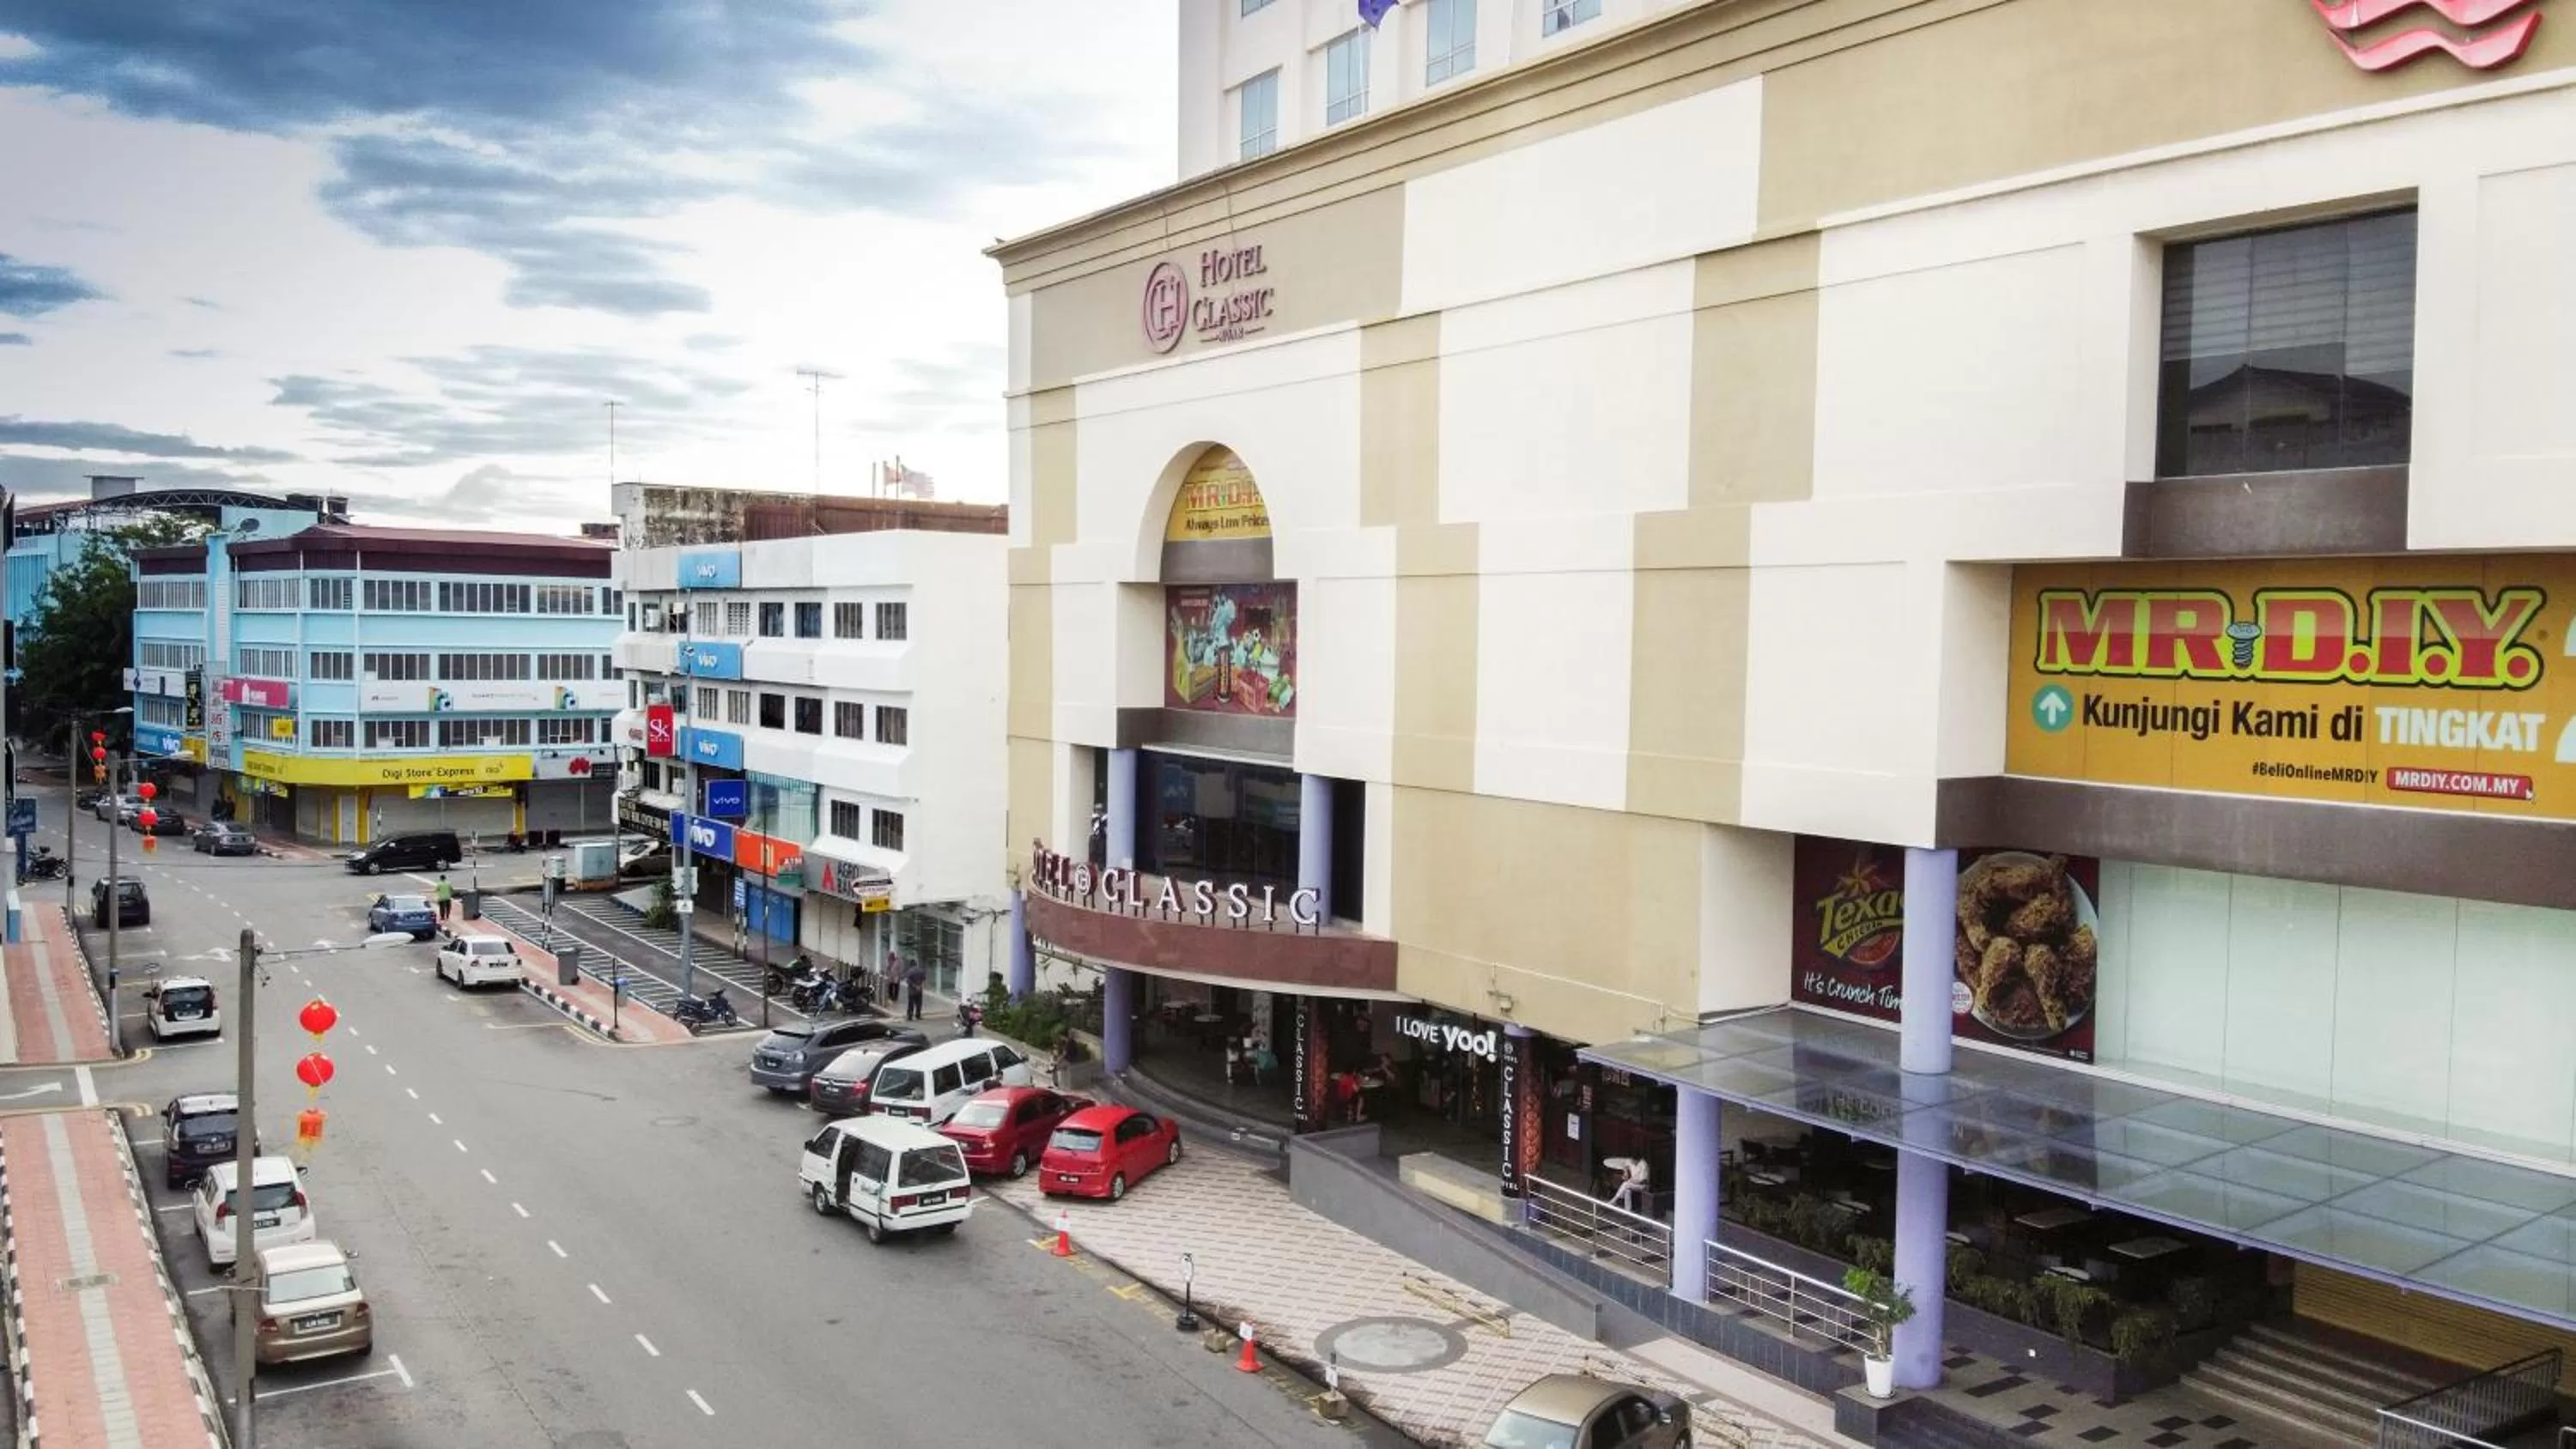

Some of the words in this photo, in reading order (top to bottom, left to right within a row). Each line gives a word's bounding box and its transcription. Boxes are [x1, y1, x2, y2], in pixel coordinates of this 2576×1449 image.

[1193, 288, 1274, 332] CLASSIC
[2083, 694, 2221, 742] Kunjungi
[2232, 700, 2319, 739] Kami
[2330, 705, 2364, 742] di
[2375, 706, 2546, 753] TINGKAT
[381, 768, 403, 779] Digi
[406, 767, 431, 778] Store
[437, 766, 475, 777] Express
[2251, 761, 2379, 785] #BeliOnlineMRDIY
[2394, 770, 2520, 795] MRDIY.COM.MY
[714, 797, 741, 805] vivo
[690, 817, 716, 848] ivo
[1103, 869, 1321, 925] CLASSIC
[1816, 890, 1905, 944] Texa
[1804, 971, 1824, 994] It's
[1826, 977, 1875, 1006] Crunch
[1878, 985, 1904, 1009] Tim
[1395, 1016, 1401, 1033] I
[1404, 1018, 1440, 1044] LOVE
[1295, 1014, 1305, 1110] CLASSIC
[1503, 1066, 1515, 1178] CLASSIC
